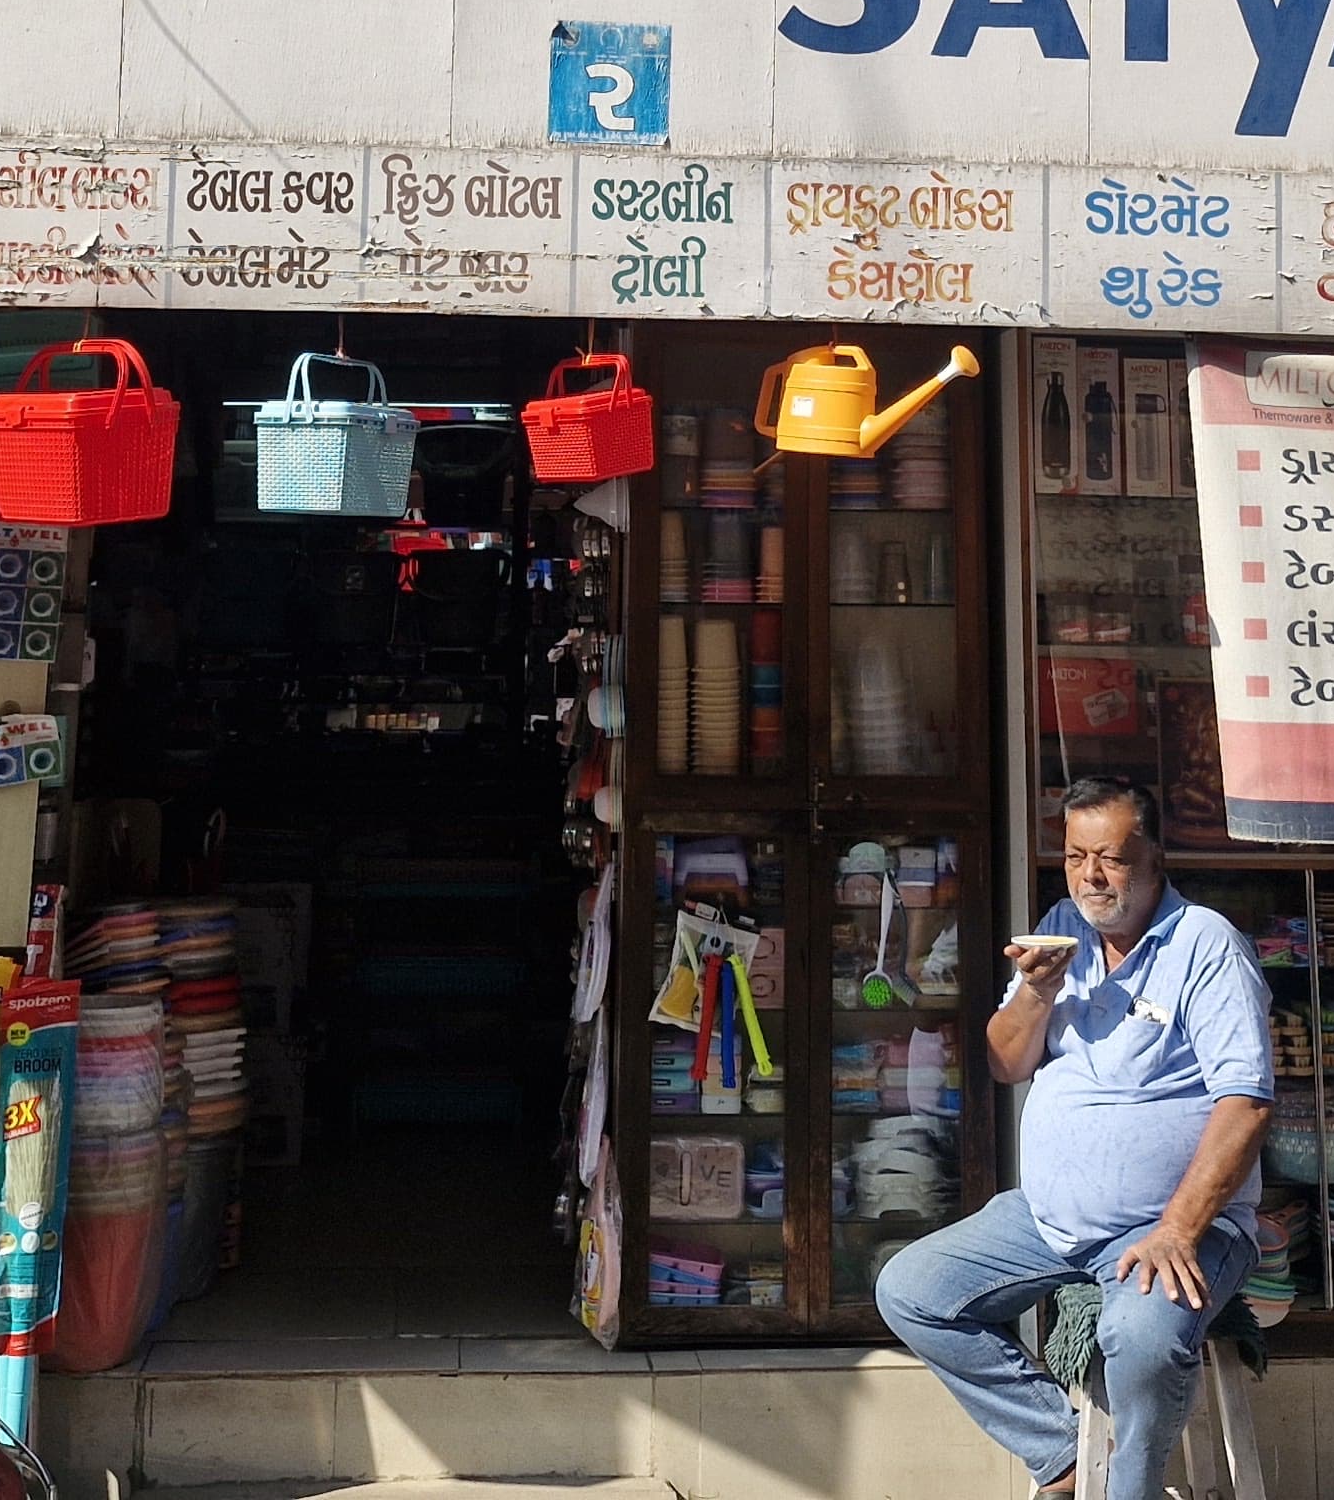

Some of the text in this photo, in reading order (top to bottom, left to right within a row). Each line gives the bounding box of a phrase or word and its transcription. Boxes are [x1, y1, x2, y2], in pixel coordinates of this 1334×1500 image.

[281, 170, 355, 214] કવર
[464, 159, 562, 219] બોટલ
[591, 163, 734, 225] ડસ્ટબીન
[909, 171, 1014, 233] બોકસ
[1253, 407, 1322, 426] Thermoware
[1324, 411, 1333, 425] &
[13, 1058, 62, 1075] BROOM
[4, 1096, 40, 1129] 3X
